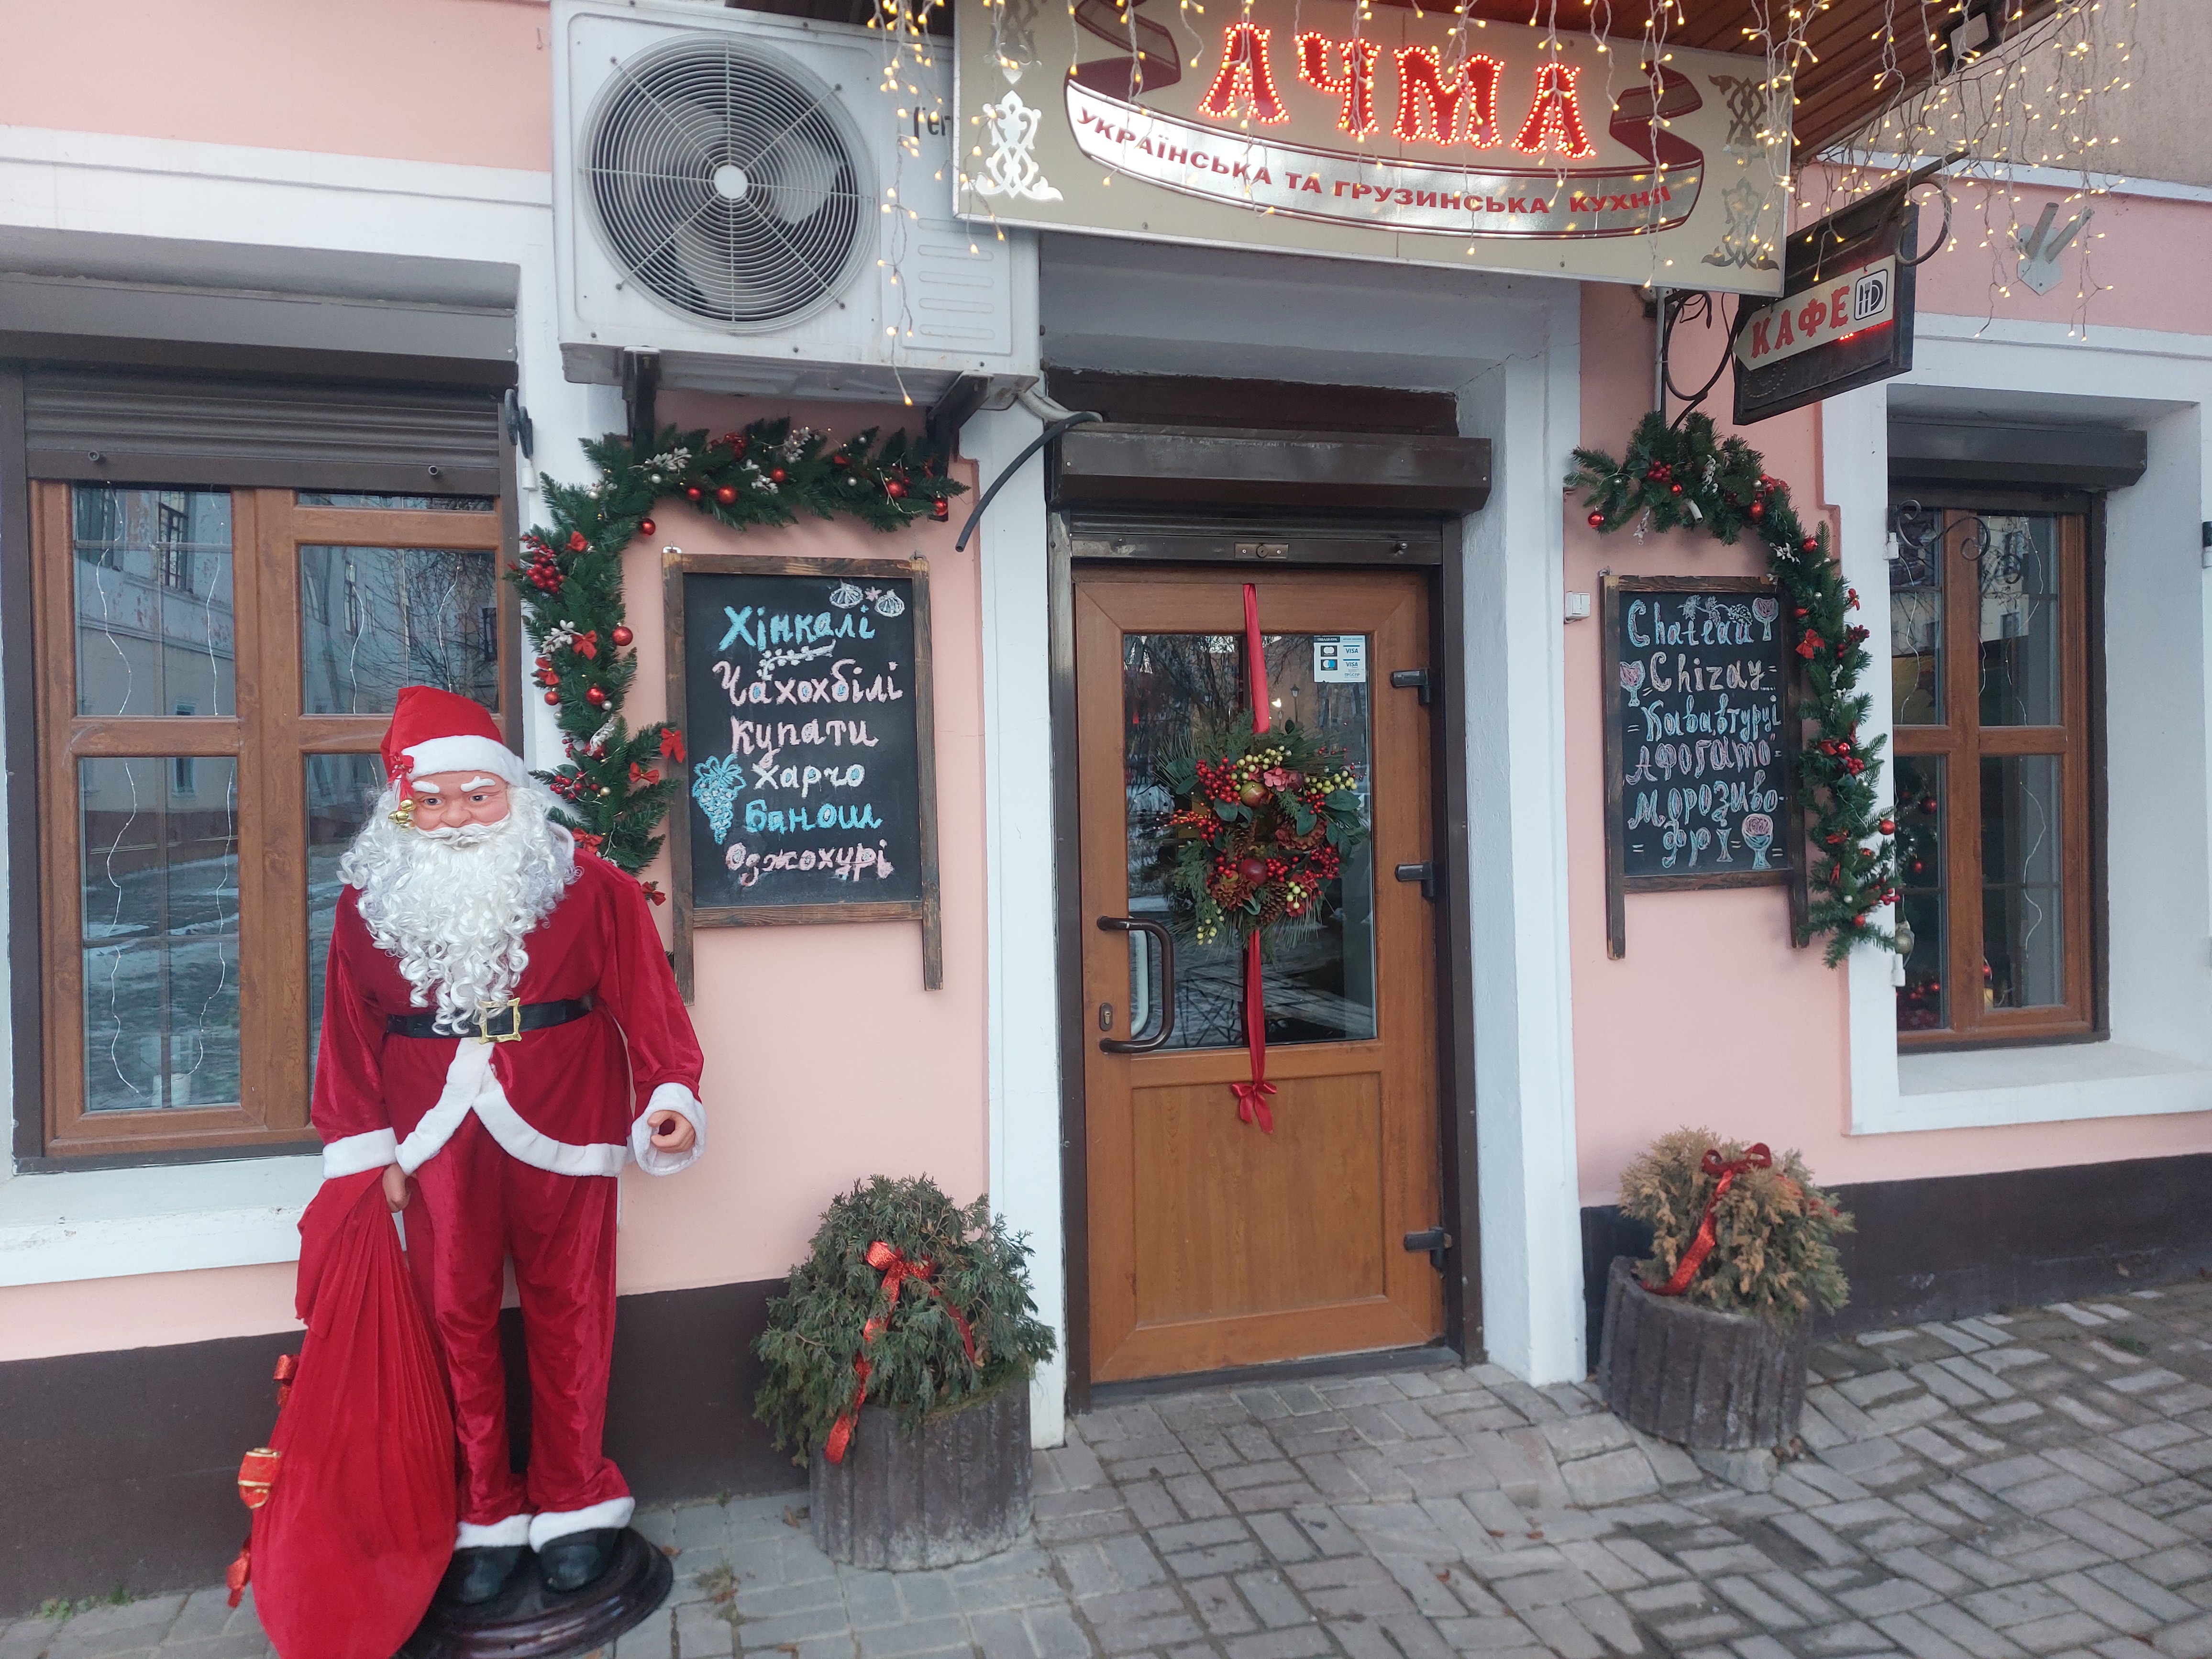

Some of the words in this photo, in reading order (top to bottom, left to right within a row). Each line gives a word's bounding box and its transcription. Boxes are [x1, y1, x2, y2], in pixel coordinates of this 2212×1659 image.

[1197, 22, 1597, 159] АЧМА
[1076, 106, 1272, 185] УКРАЇНСЬКА
[1285, 171, 1322, 194] ТА
[1334, 180, 1549, 214] ГРУЗИНСЬКА
[1570, 185, 1672, 213] КУХНЯ
[1751, 285, 1850, 359] КАФЕ
[718, 605, 875, 652] Хінкалі
[1628, 599, 1754, 648] Chateau
[712, 659, 903, 707] Чахохбілі
